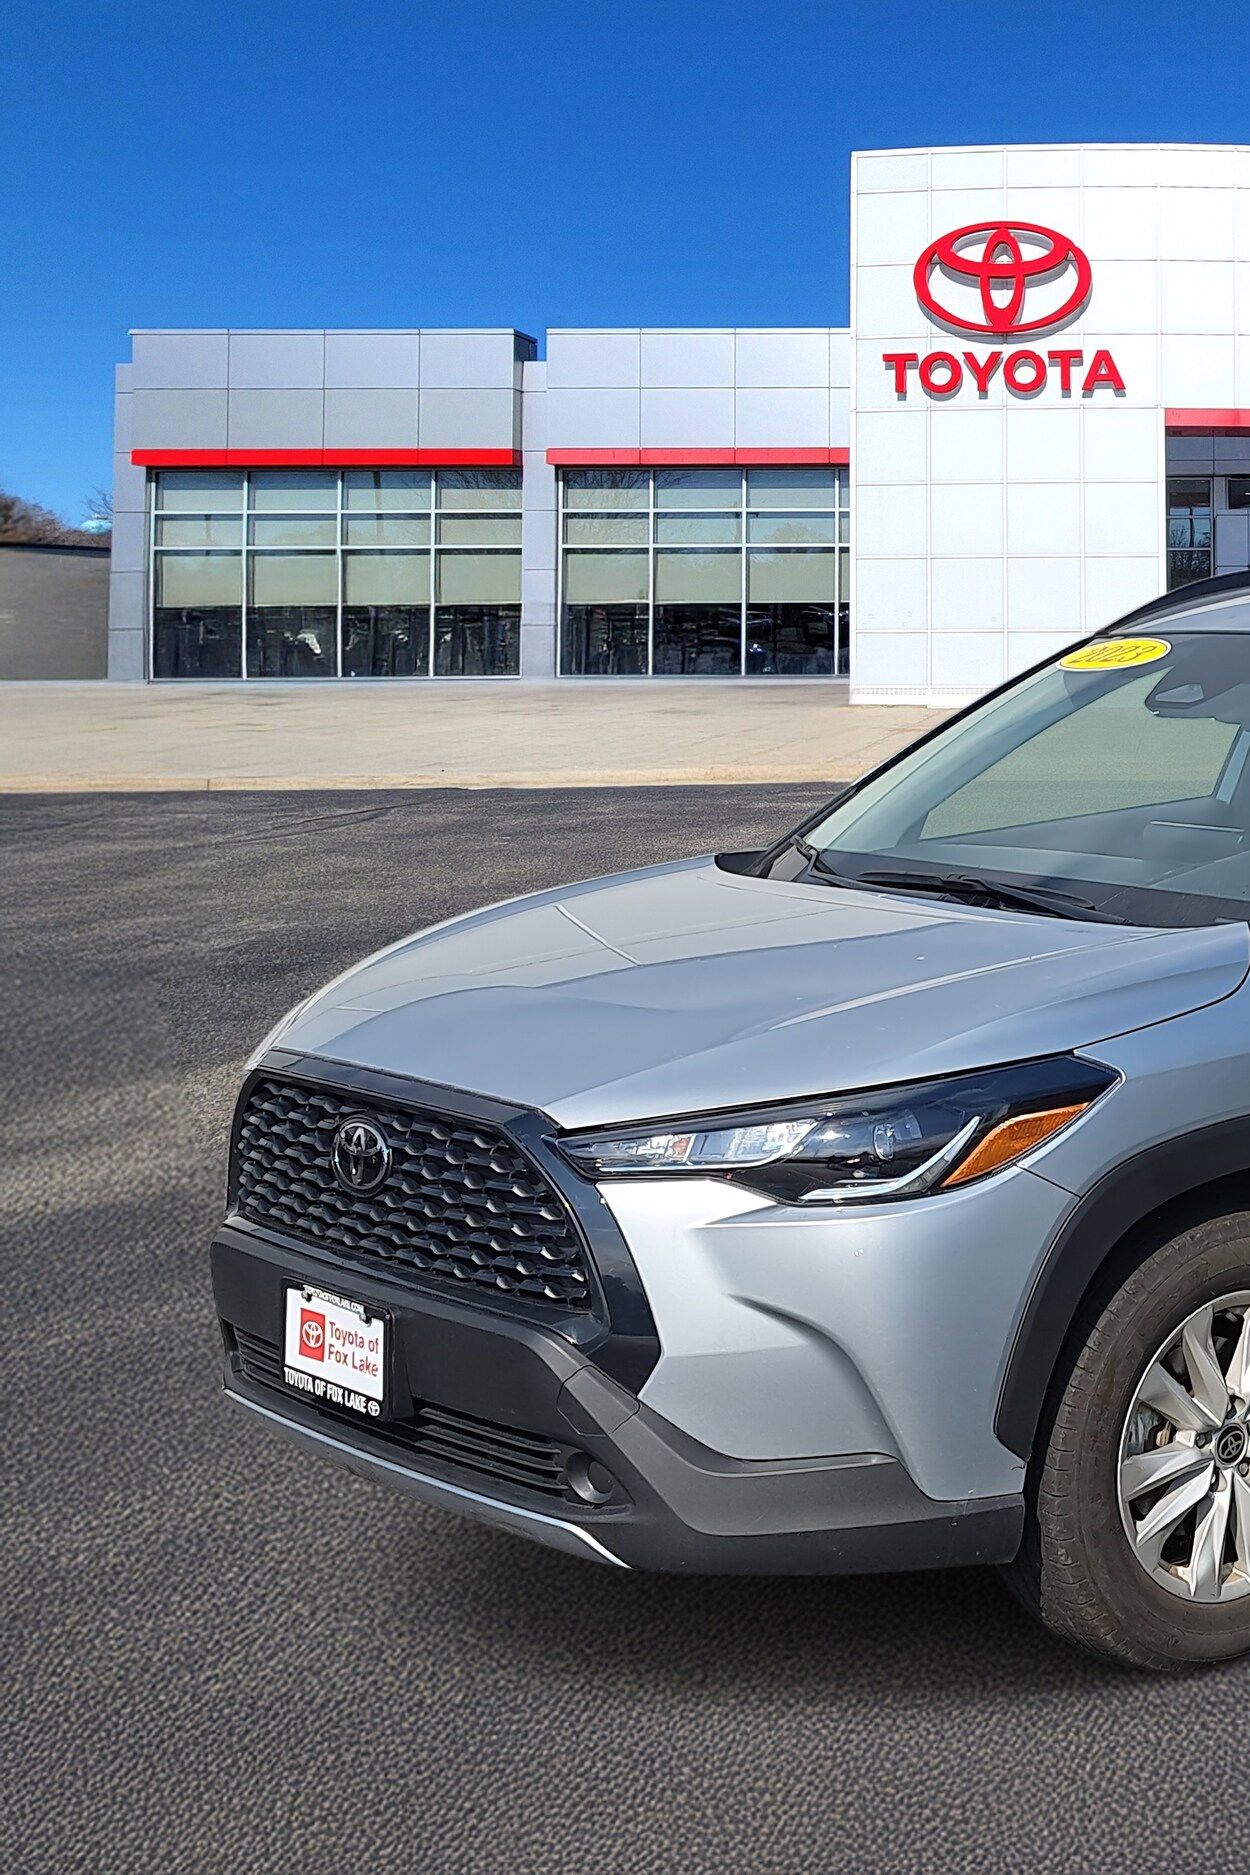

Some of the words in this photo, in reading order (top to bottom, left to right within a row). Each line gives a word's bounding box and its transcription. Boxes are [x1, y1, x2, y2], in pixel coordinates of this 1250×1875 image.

[882, 350, 1126, 399] TOYOTA
[1067, 644, 1158, 664] 2023
[328, 1321, 365, 1348] Toyota
[368, 1337, 379, 1354] of
[328, 1343, 348, 1367] Fox
[352, 1351, 379, 1378] Lake
[283, 1366, 314, 1393] TOYOTA
[315, 1380, 326, 1396] OF
[327, 1384, 343, 1405] FOX
[344, 1390, 367, 1414] LAKE
